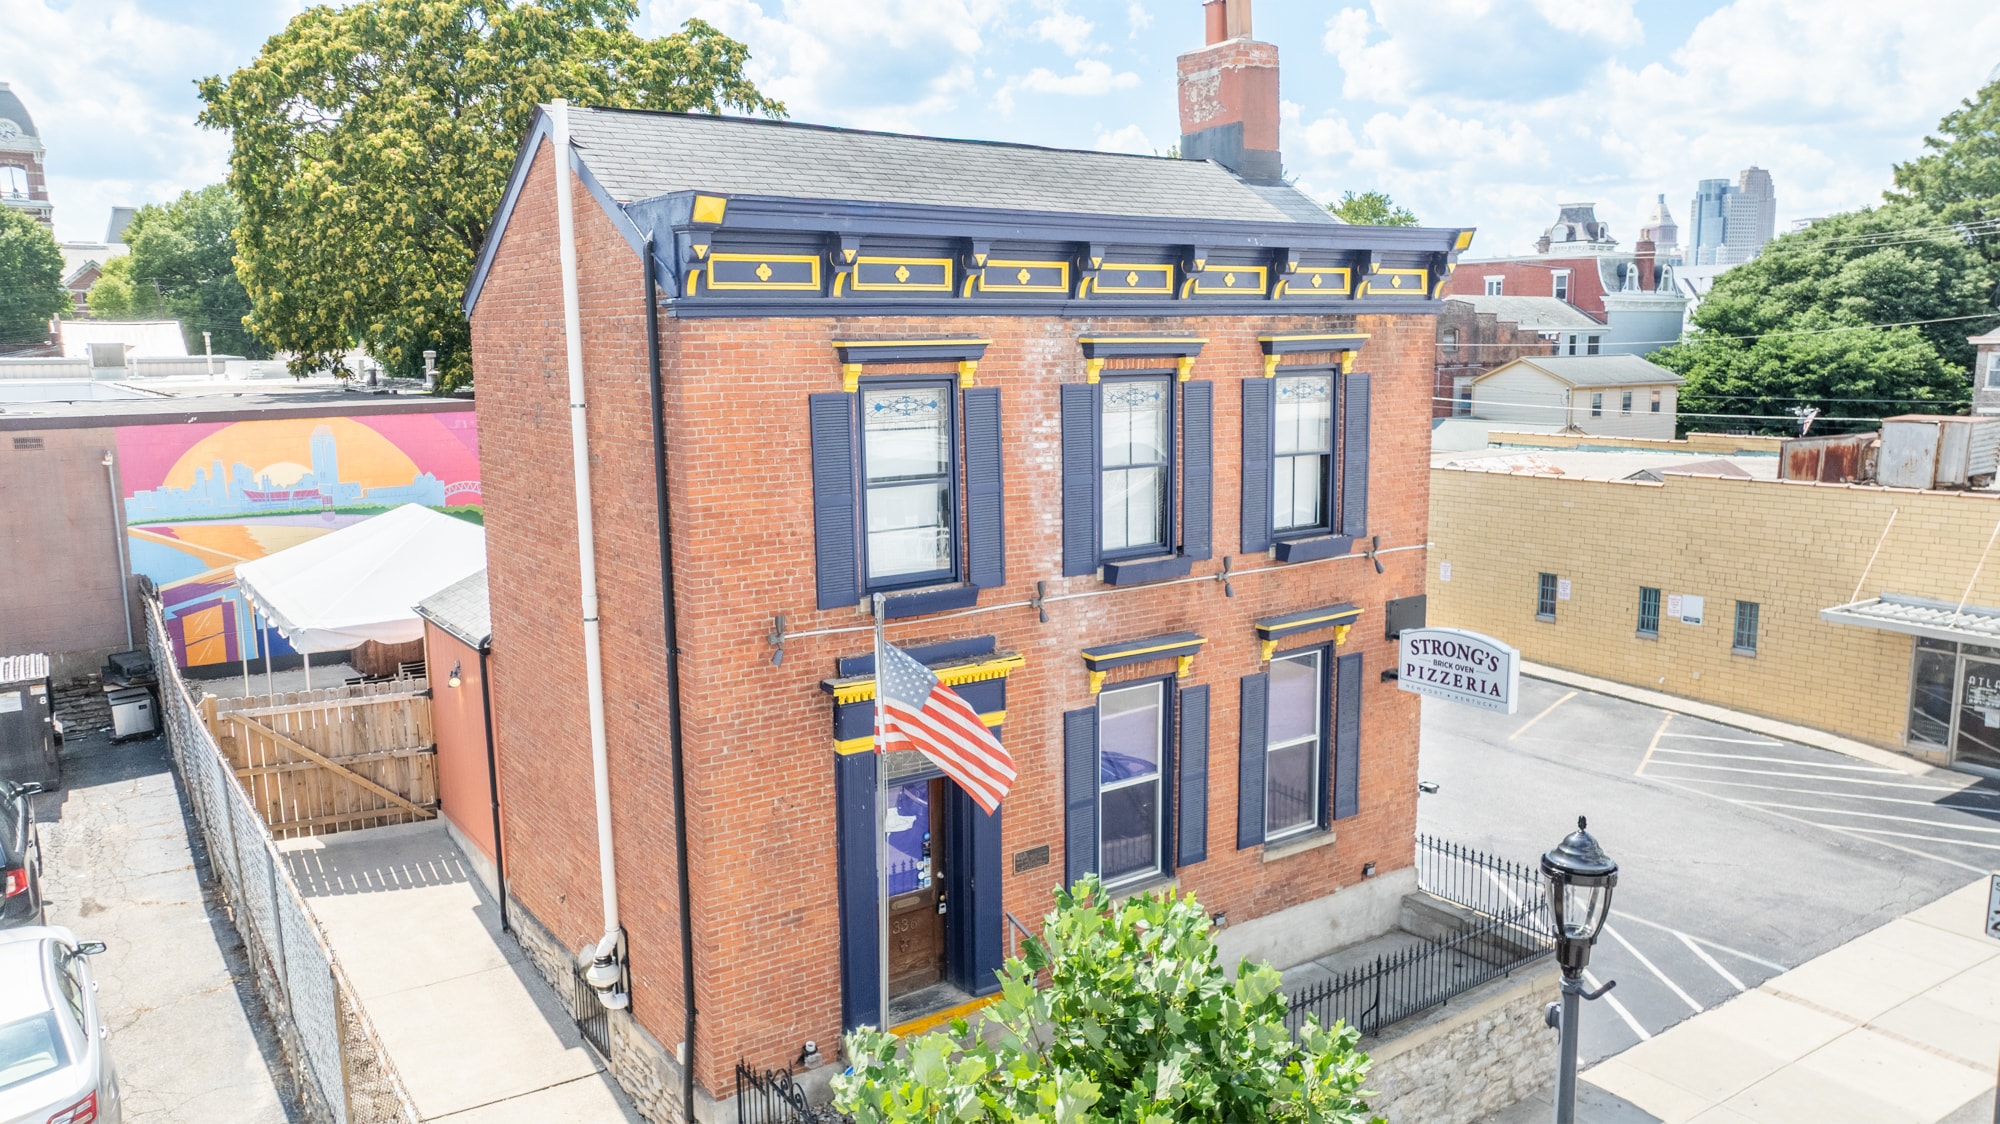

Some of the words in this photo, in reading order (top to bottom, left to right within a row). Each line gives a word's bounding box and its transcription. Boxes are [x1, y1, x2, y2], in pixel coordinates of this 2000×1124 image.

[1410, 639, 1499, 672] STRONG'S
[1433, 659, 1453, 670] BRICK
[1455, 665, 1474, 674] OVEN
[1406, 663, 1501, 697] PIZZERIA
[40, 696, 47, 705] 8
[1406, 684, 1443, 696] NEWPORT
[1454, 695, 1499, 709] KENTUCKY
